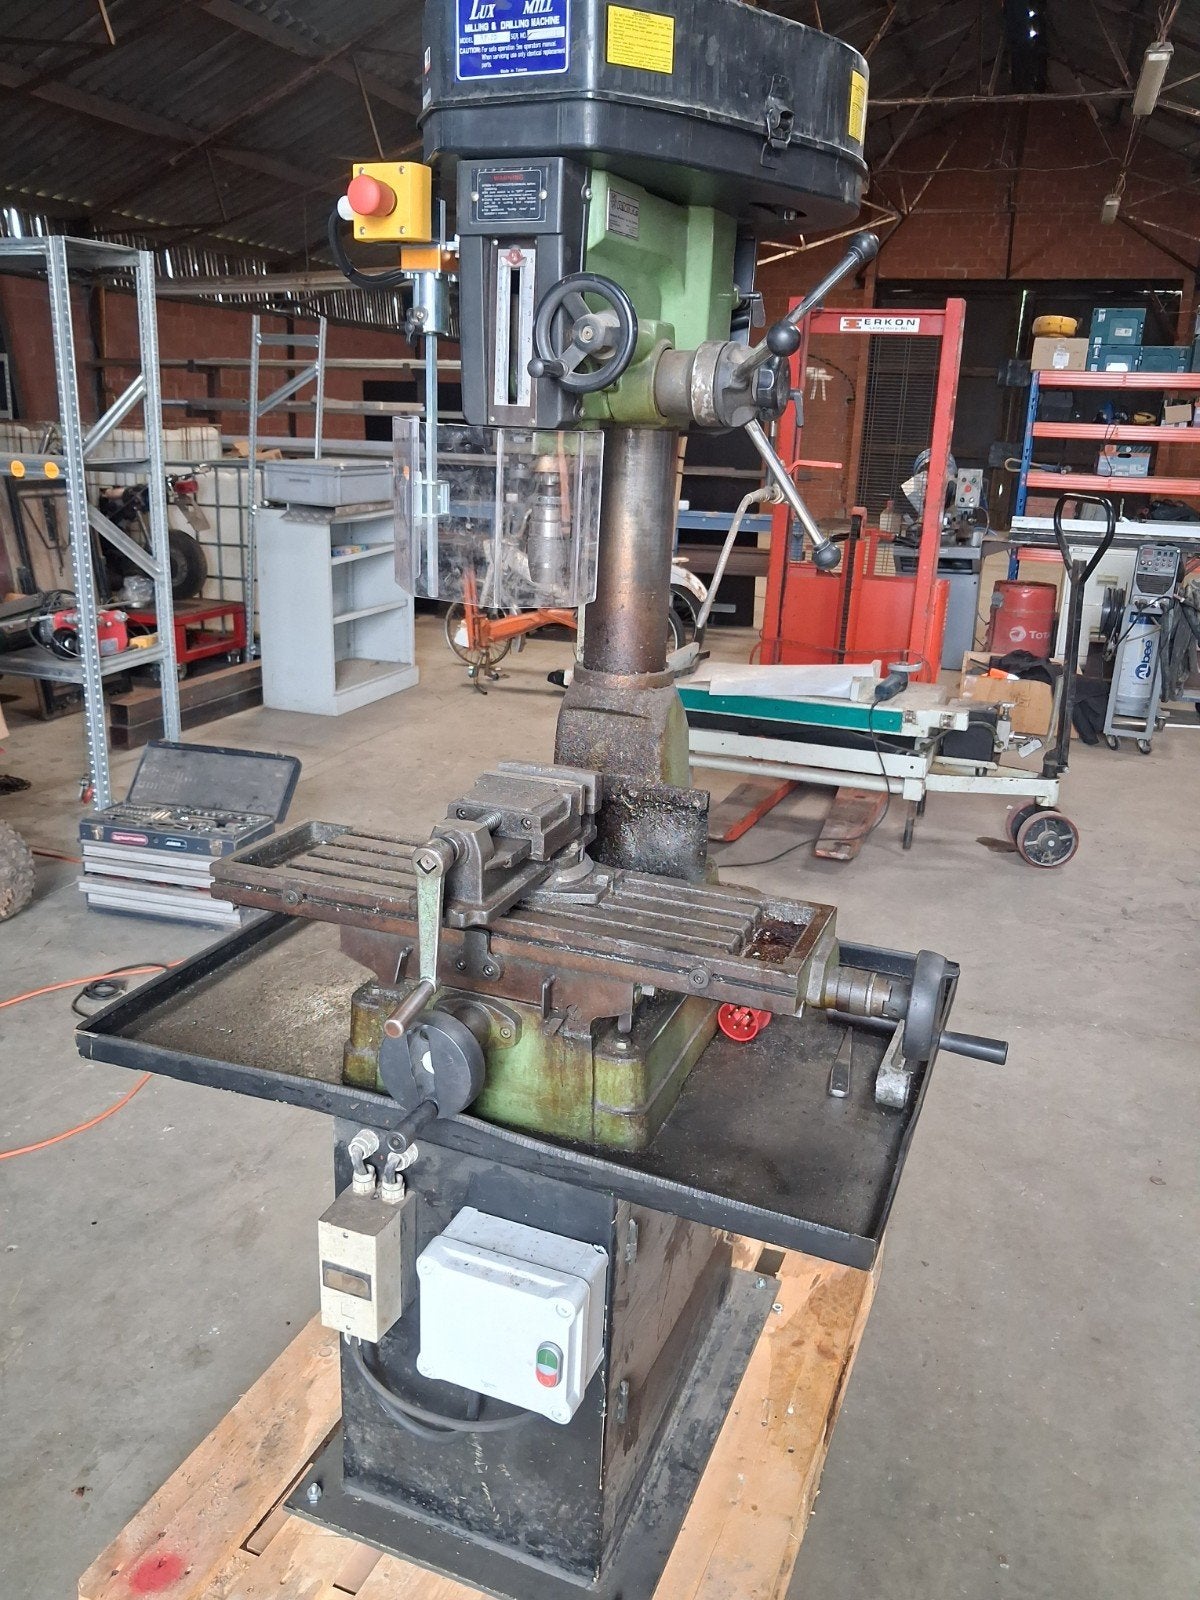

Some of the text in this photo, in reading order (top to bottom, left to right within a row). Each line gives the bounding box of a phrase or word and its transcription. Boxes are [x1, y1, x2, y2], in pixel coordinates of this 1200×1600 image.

[523, 0, 554, 14] MILL
[464, 22, 490, 33] MILLING
[500, 19, 530, 30] DRILLING
[530, 15, 560, 27] MACHINE
[864, 318, 916, 326] ERKON
